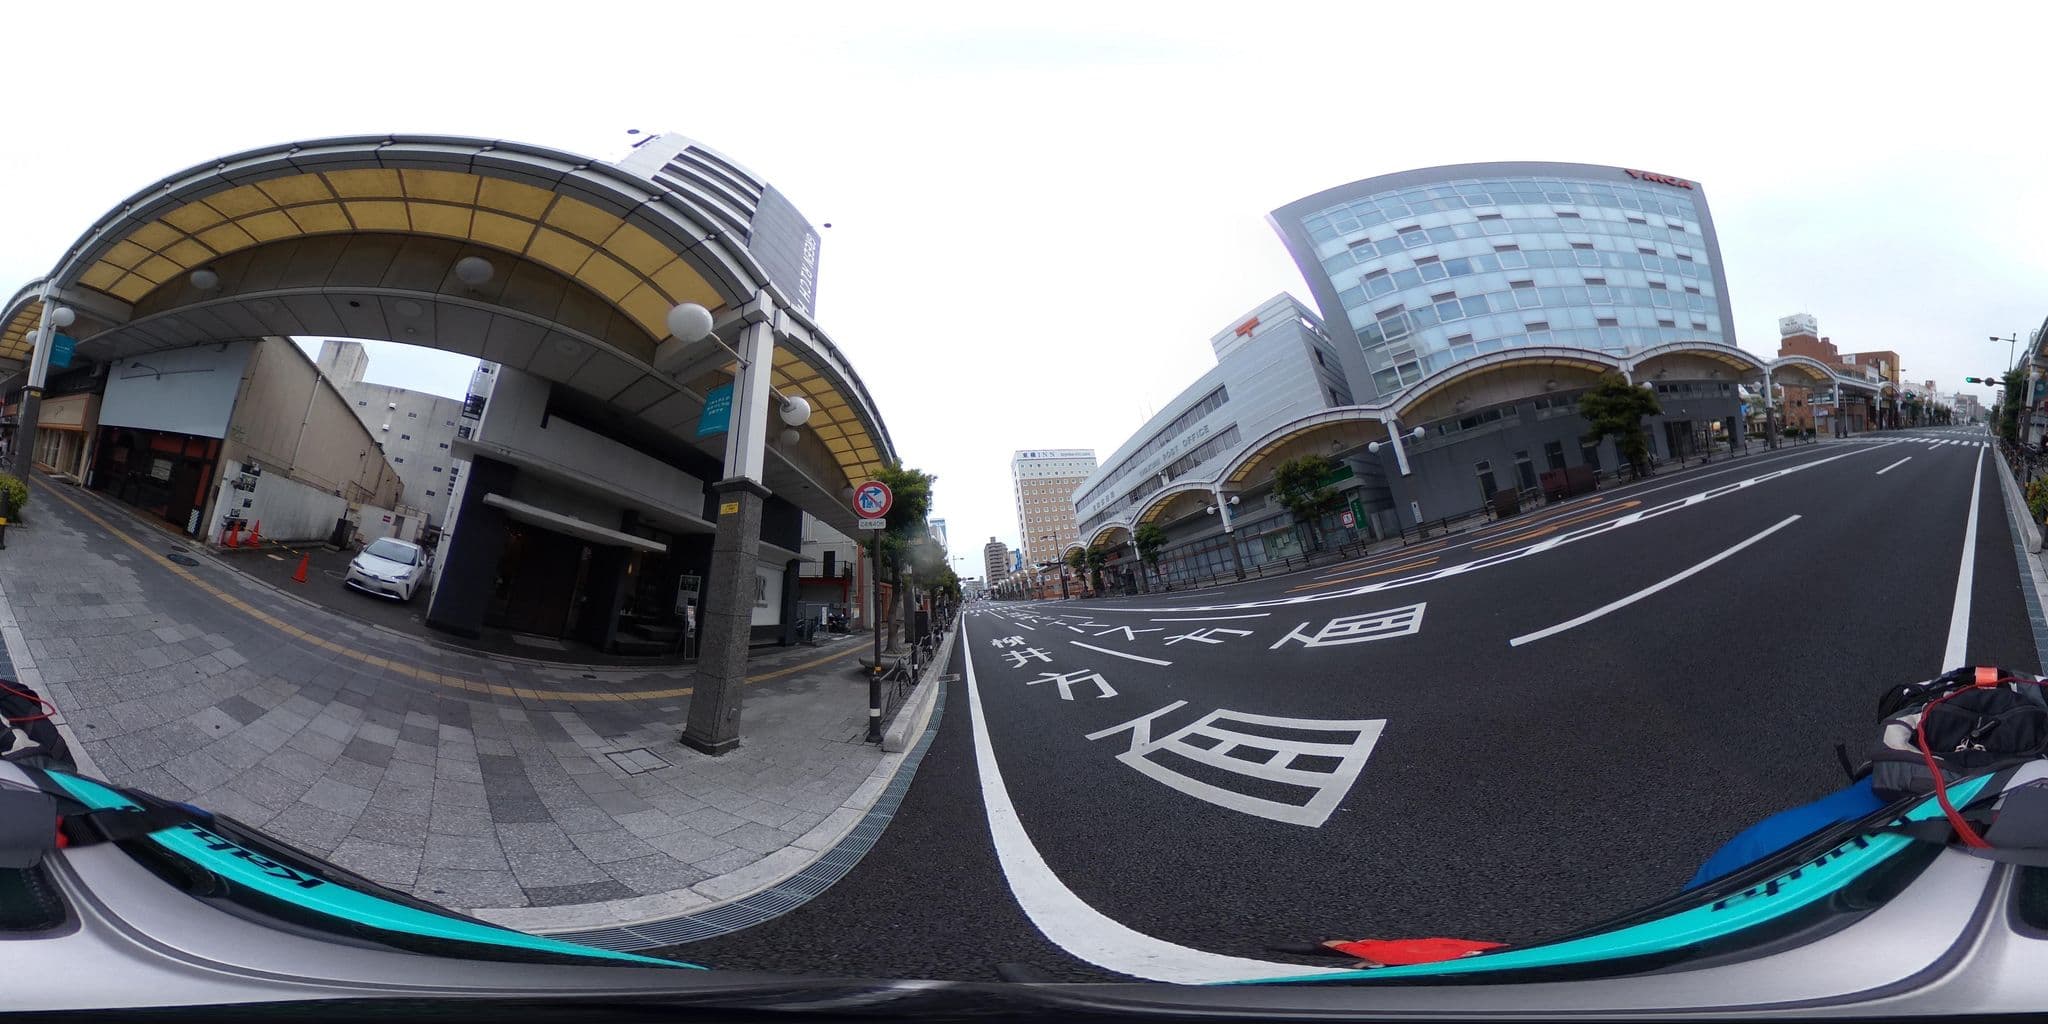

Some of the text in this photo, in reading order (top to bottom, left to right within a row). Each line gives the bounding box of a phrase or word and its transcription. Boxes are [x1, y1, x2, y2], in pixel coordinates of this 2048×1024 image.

[1625, 169, 1693, 190] YMCA
[1182, 424, 1211, 447] OFFICE
[989, 635, 1387, 829] 柳井方面
